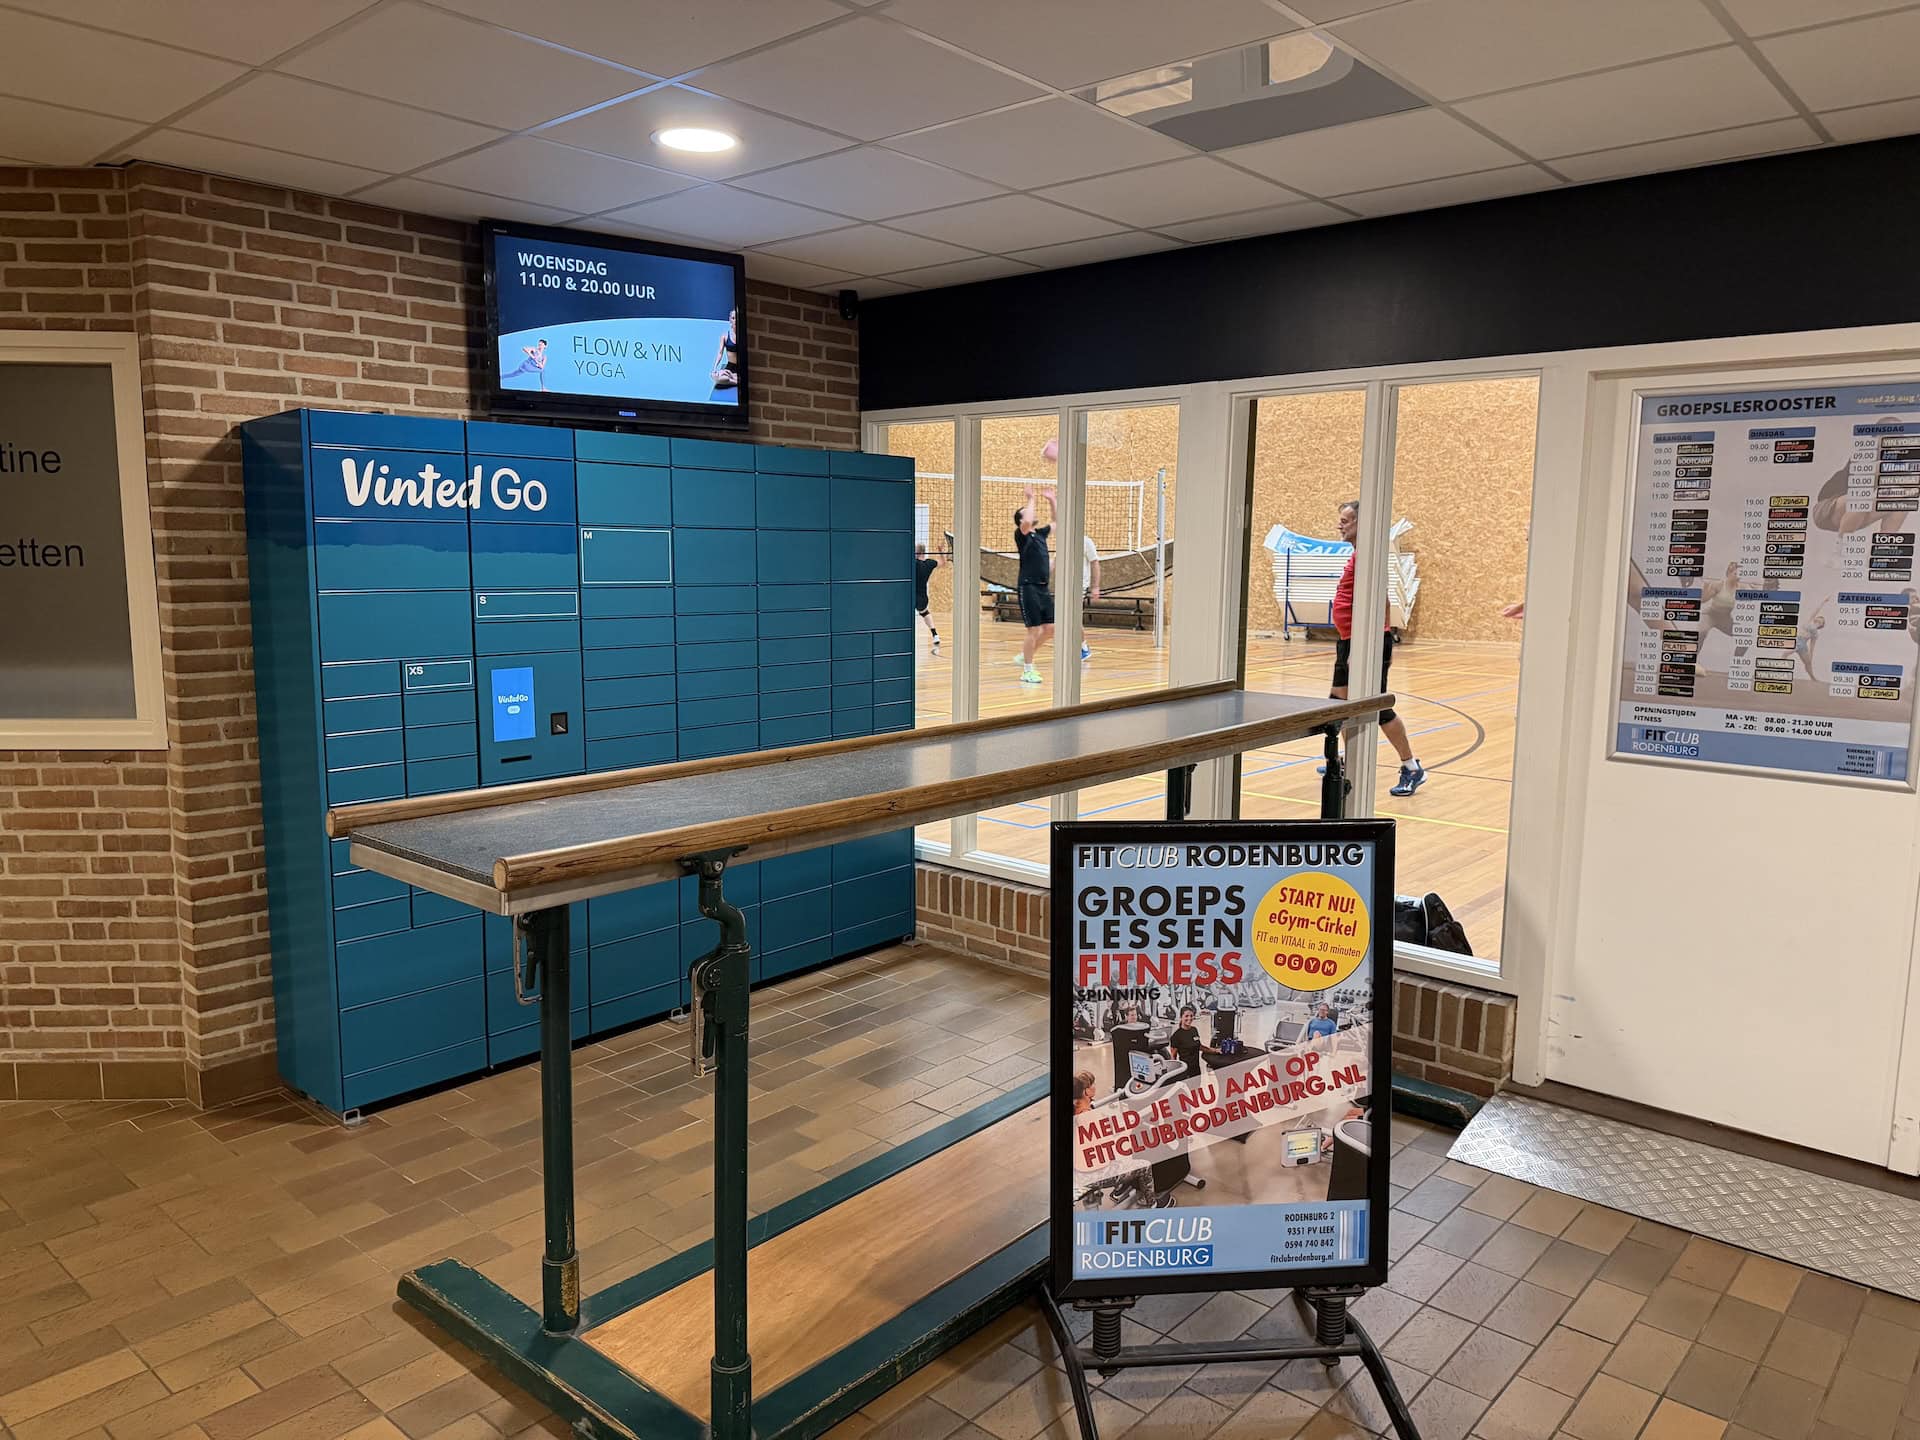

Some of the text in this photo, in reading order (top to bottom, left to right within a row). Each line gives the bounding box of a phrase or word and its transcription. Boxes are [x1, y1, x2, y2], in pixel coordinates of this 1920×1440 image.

[517, 252, 608, 277] WOENSDAG
[519, 272, 656, 301] 11.00 & 20.00 UUR
[573, 335, 682, 363] FLOW & YIN
[574, 360, 626, 379] YOGA
[1657, 396, 1837, 417] GROEPSLESROOSTER
[1751, 430, 1785, 438] DINSDAG
[1857, 425, 1905, 434] WOENSDAG
[1655, 434, 1692, 442] MAANDAG
[1854, 440, 1875, 448] 09.00
[1853, 452, 1874, 460] 09.00
[341, 458, 548, 512] Vinted Go
[1849, 502, 1870, 510] 11.00
[583, 531, 593, 541] M
[1846, 534, 1905, 544] 19.00 tone
[1670, 556, 1694, 565] tone
[1644, 589, 1688, 597] DONDERDAG
[1737, 591, 1769, 600] VRIJDAG
[1840, 594, 1883, 602] ZATERDAG
[479, 596, 487, 605] S
[1762, 603, 1784, 612] YOGA
[1759, 639, 1785, 647] PILATES
[409, 667, 424, 676] XS
[1834, 664, 1870, 672] ZONDAG
[1634, 706, 1697, 717] OPENINGSTIJDEN
[1634, 715, 1662, 723] FITNESS
[1764, 725, 1785, 733] 09.00
[1632, 742, 1698, 756] RODENBURG
[1078, 843, 1365, 869] FITCLUB RODENBURG
[1078, 885, 1246, 917] GROEPS
[1279, 886, 1356, 914] START NU!
[1269, 909, 1358, 938] eGym-Cirkel
[1079, 918, 1244, 950] LESSEN
[1256, 930, 1362, 957] FIT en VITAAL in 30 minuten
[1079, 951, 1243, 987] FITNESS
[1077, 987, 1161, 1001] SPINNING
[1078, 1051, 1321, 1144] MELD JE NU AAN OP
[1082, 1064, 1367, 1168] FITCLUBRODENBURG.NL
[1284, 1211, 1335, 1222] RODENBURG 2
[1105, 1217, 1213, 1246] FITCLUB
[1287, 1225, 1335, 1236] 9351 PV LEEK
[1285, 1238, 1334, 1249] 0594 740 842
[1082, 1248, 1210, 1270] RODENBURG
[1270, 1251, 1334, 1264] fitclubrodenburg.nl
